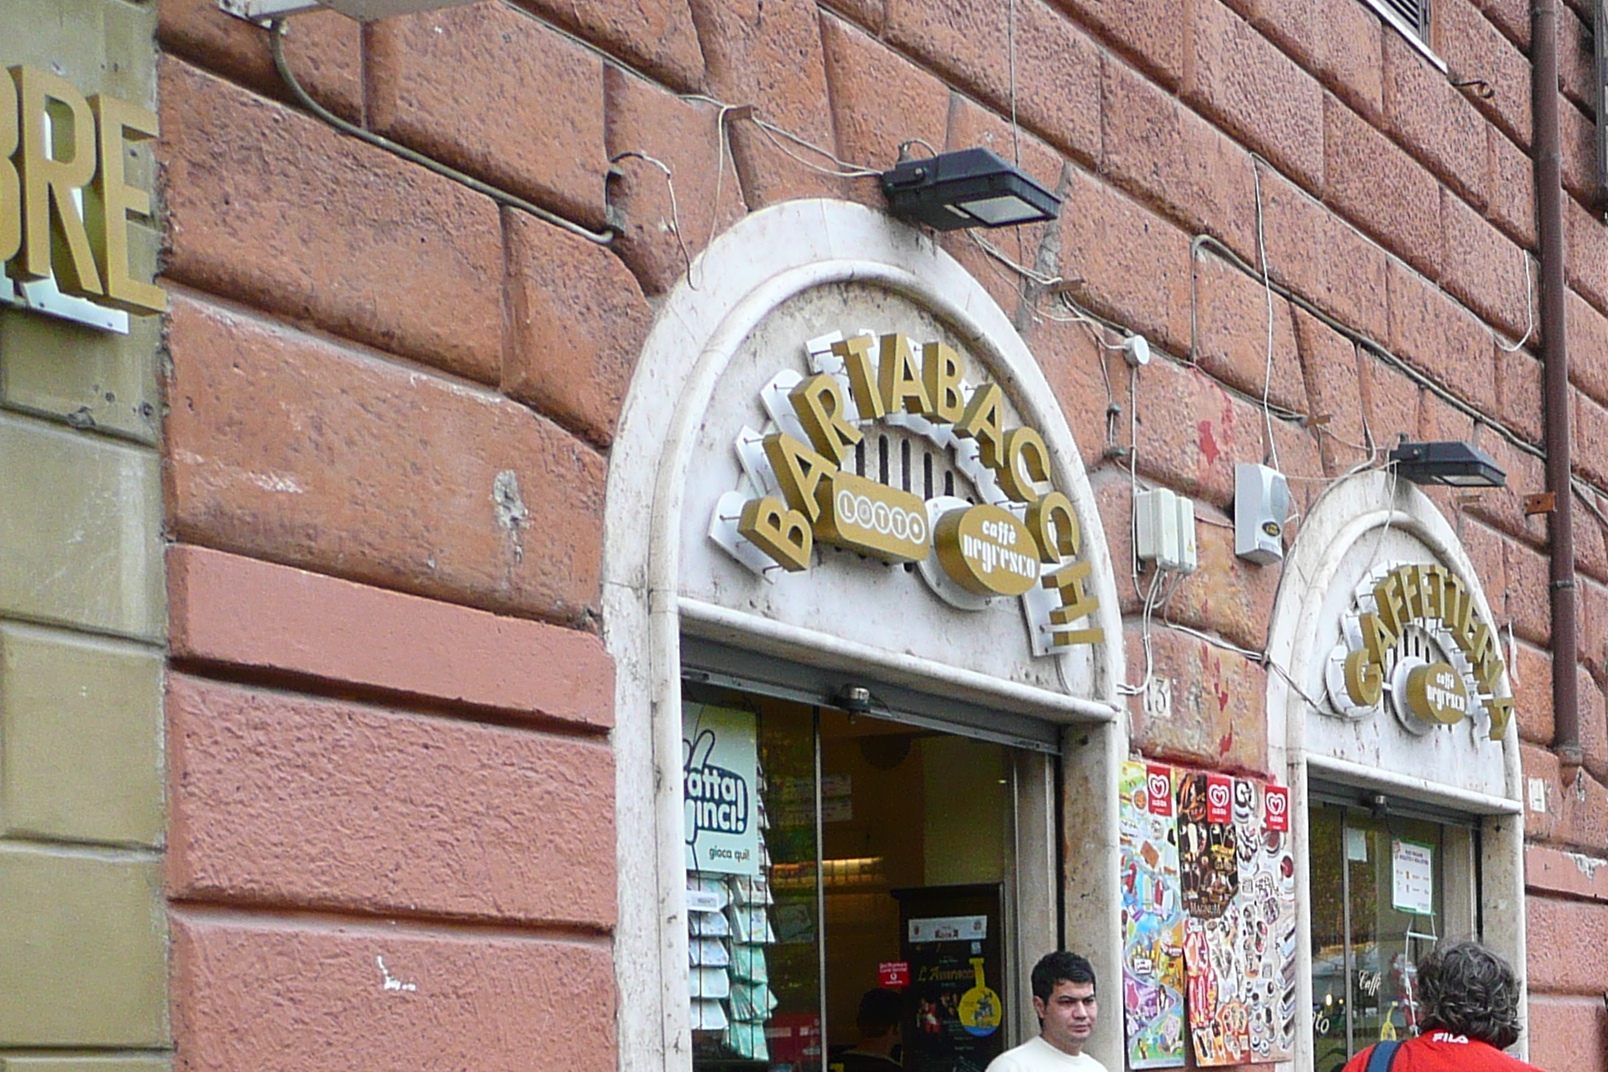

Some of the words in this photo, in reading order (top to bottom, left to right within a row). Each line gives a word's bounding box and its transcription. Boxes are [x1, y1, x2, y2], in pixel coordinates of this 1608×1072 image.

[738, 374, 863, 572] BAR
[831, 332, 1105, 646] TABACCHI
[838, 489, 927, 545] LOTTO
[981, 519, 1017, 544] caffè
[709, 845, 732, 860] gioca
[1432, 1032, 1469, 1044] FILA
